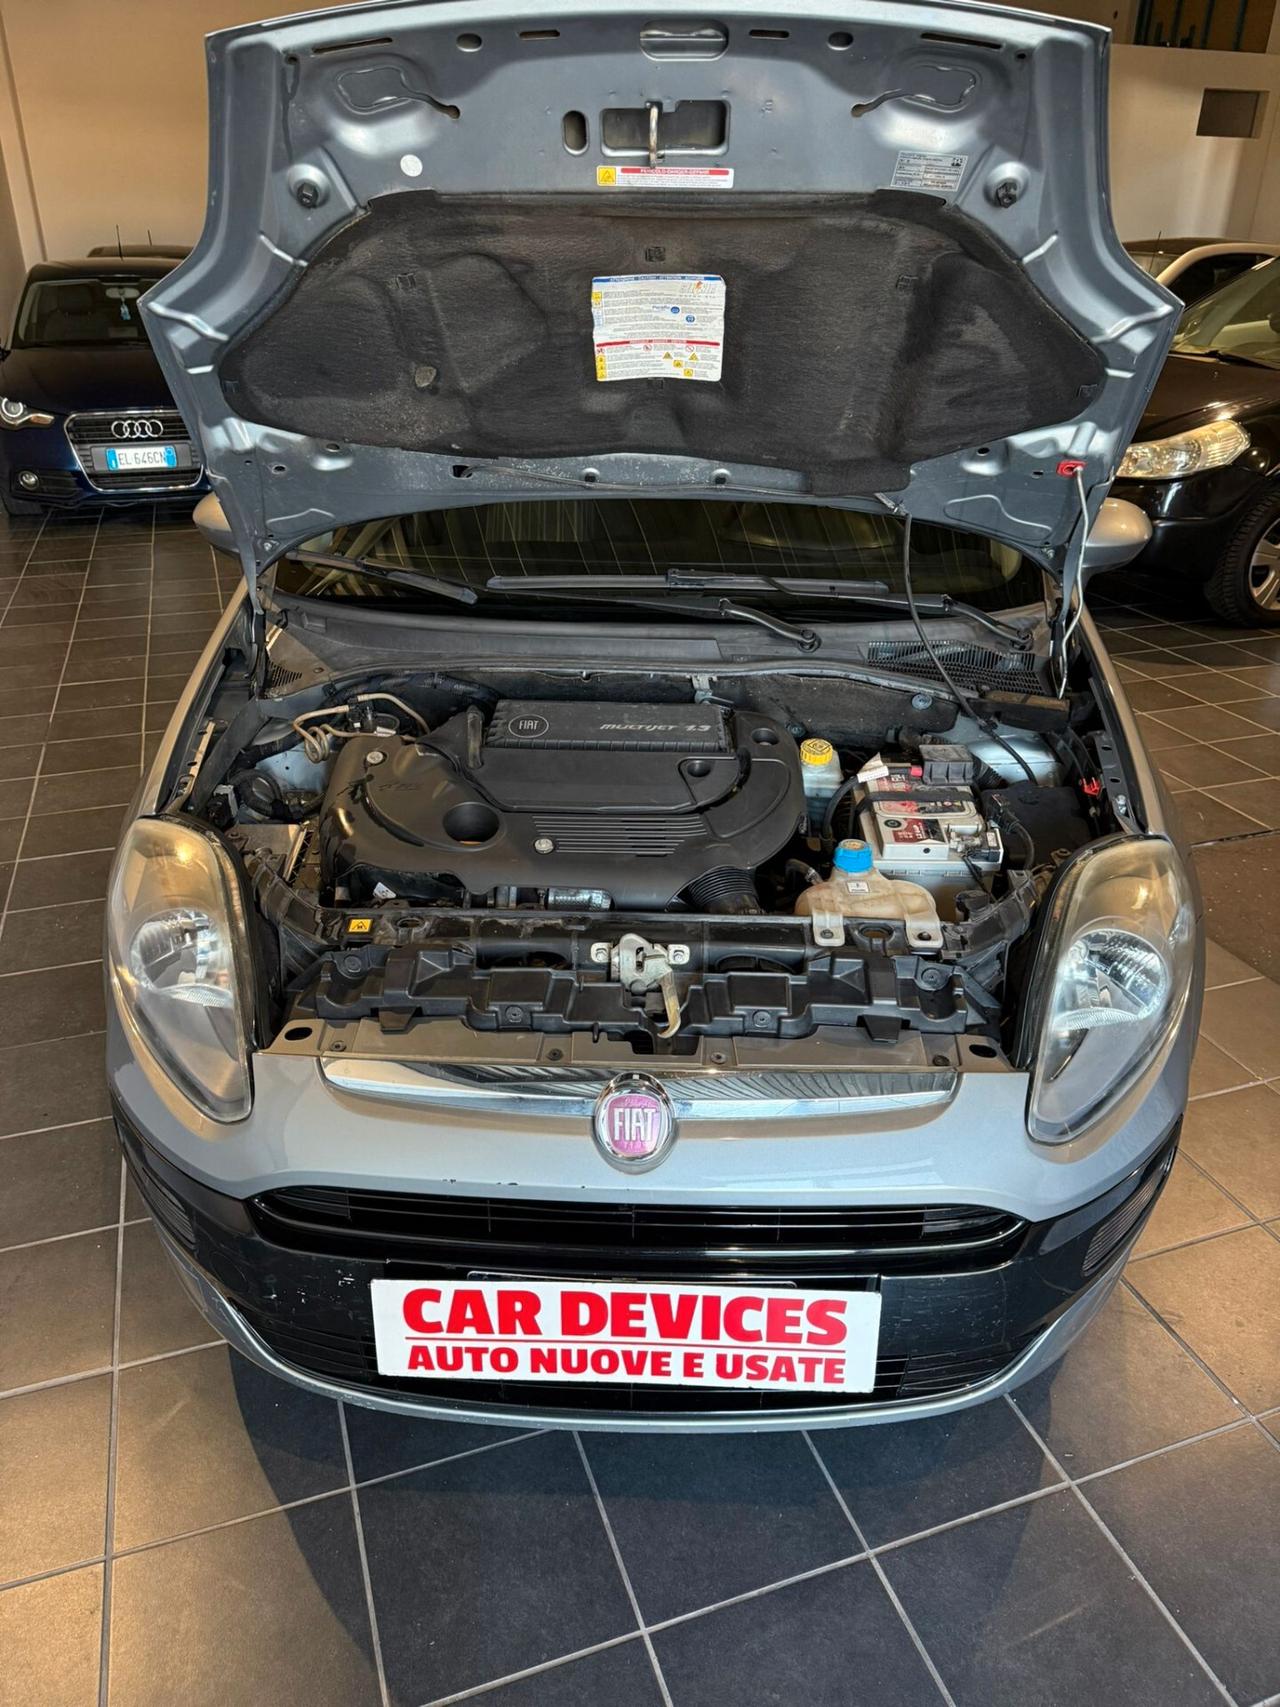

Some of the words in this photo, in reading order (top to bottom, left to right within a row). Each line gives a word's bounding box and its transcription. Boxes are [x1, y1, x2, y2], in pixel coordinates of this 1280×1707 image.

[118, 453, 131, 465] EL
[519, 720, 540, 730] FIAT
[685, 724, 711, 732] 1.3
[613, 1107, 656, 1141] FIAT
[403, 1288, 542, 1335] CAR
[561, 1290, 847, 1345] DEVICES
[408, 1345, 519, 1373] AUTO
[531, 1347, 672, 1377] NUOVE
[684, 1352, 705, 1378] E
[716, 1354, 846, 1384] USATE
